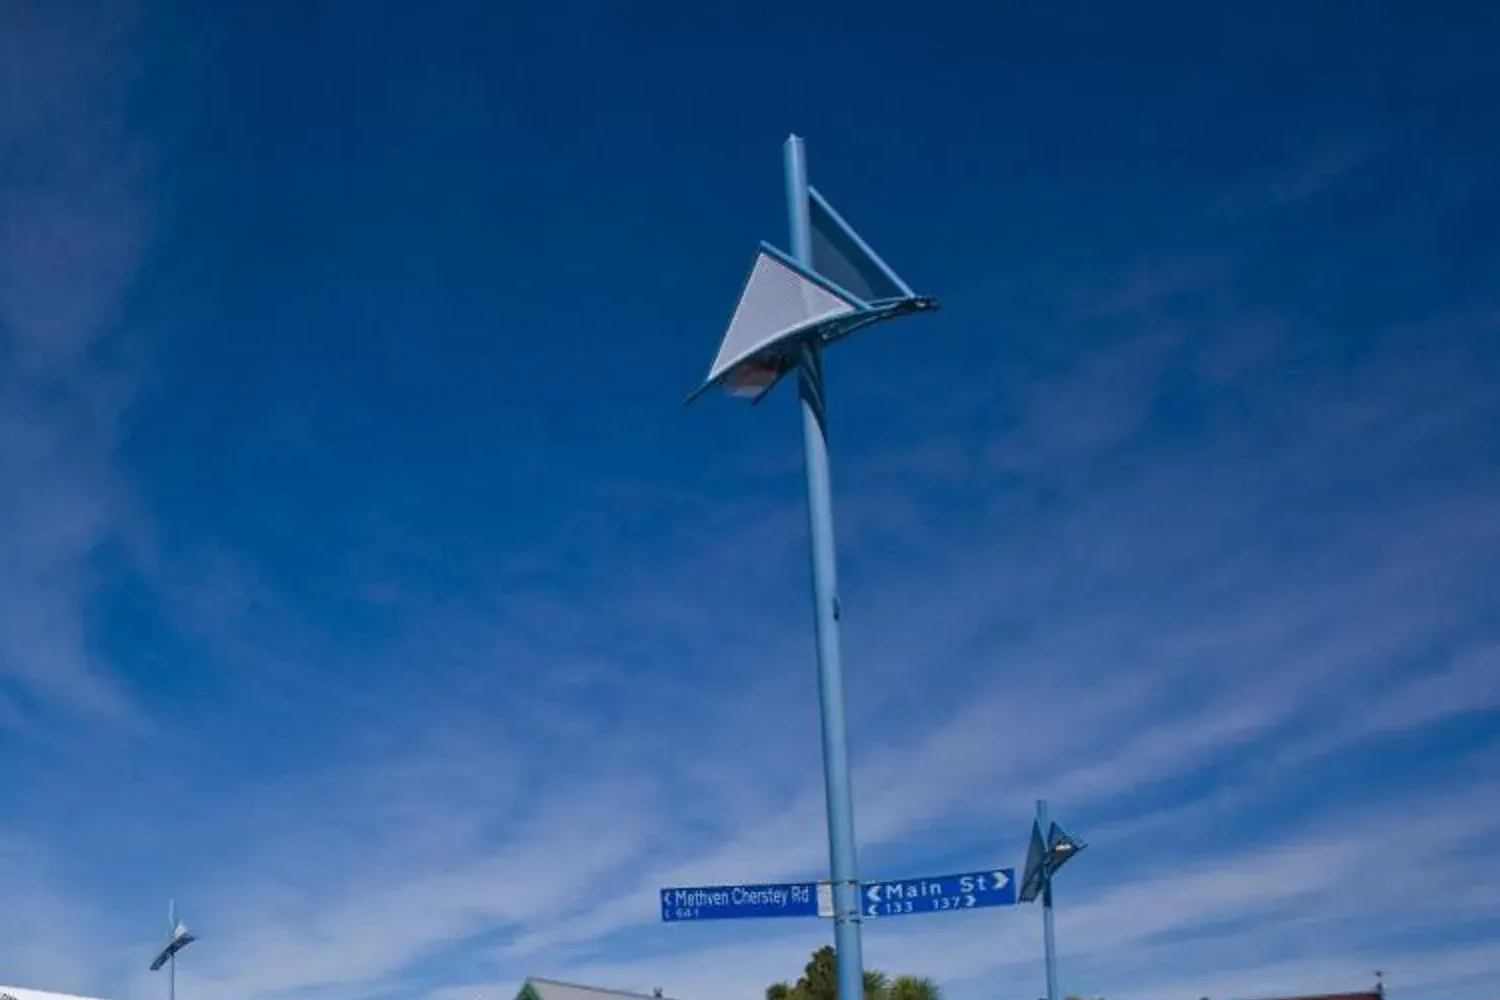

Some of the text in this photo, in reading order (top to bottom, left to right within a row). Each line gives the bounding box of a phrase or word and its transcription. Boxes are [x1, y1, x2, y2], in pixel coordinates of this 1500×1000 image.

[675, 889, 729, 907] Methven
[791, 885, 809, 904] Rd
[886, 874, 987, 899] Main St
